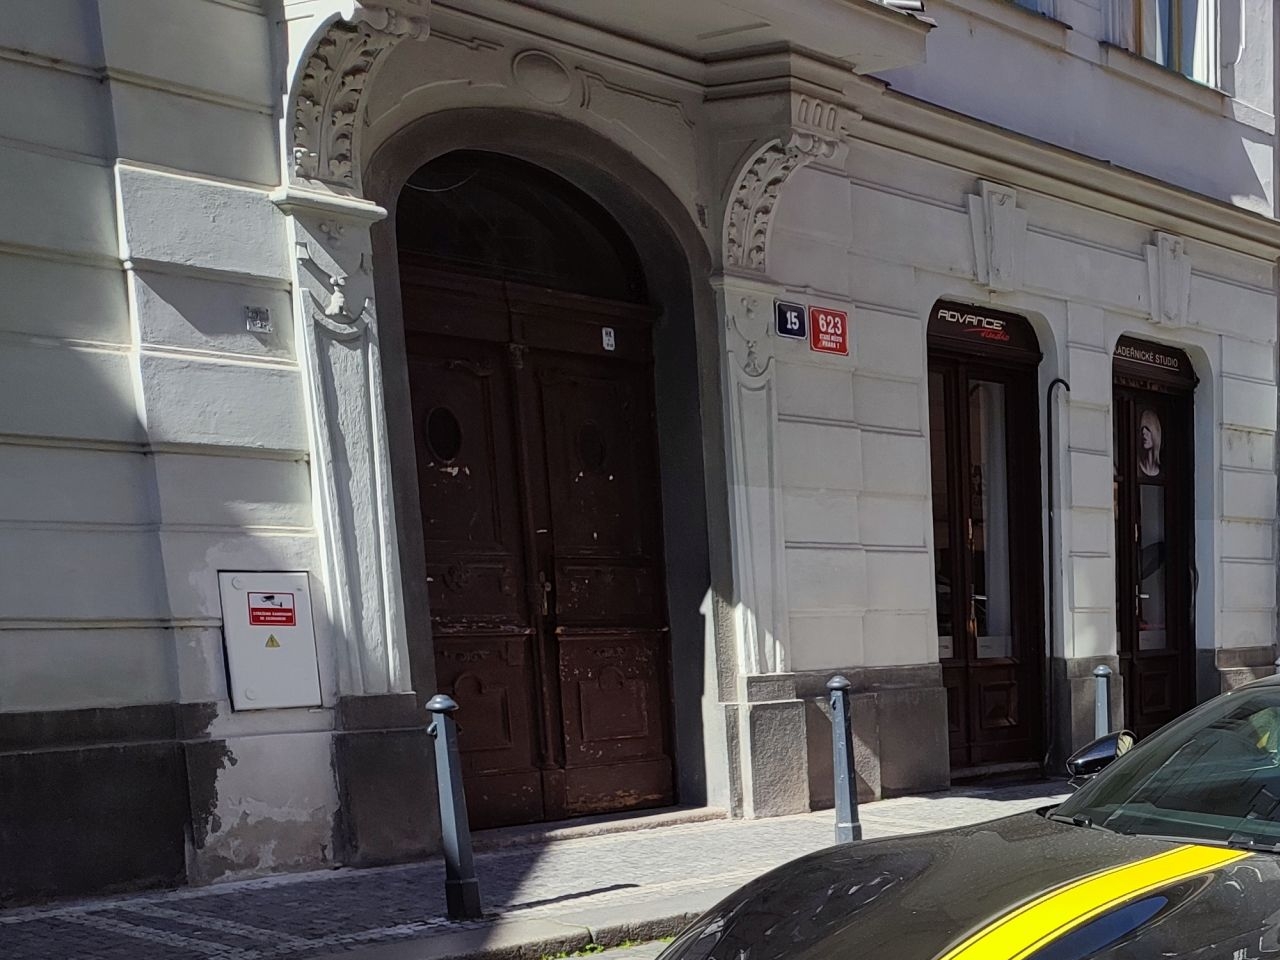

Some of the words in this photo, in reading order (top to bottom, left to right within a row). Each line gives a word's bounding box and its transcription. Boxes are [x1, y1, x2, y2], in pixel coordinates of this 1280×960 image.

[786, 311, 800, 330] 15
[818, 314, 842, 334] 623
[938, 309, 1003, 330] ADVANCE
[1155, 354, 1178, 367] STUDIO
